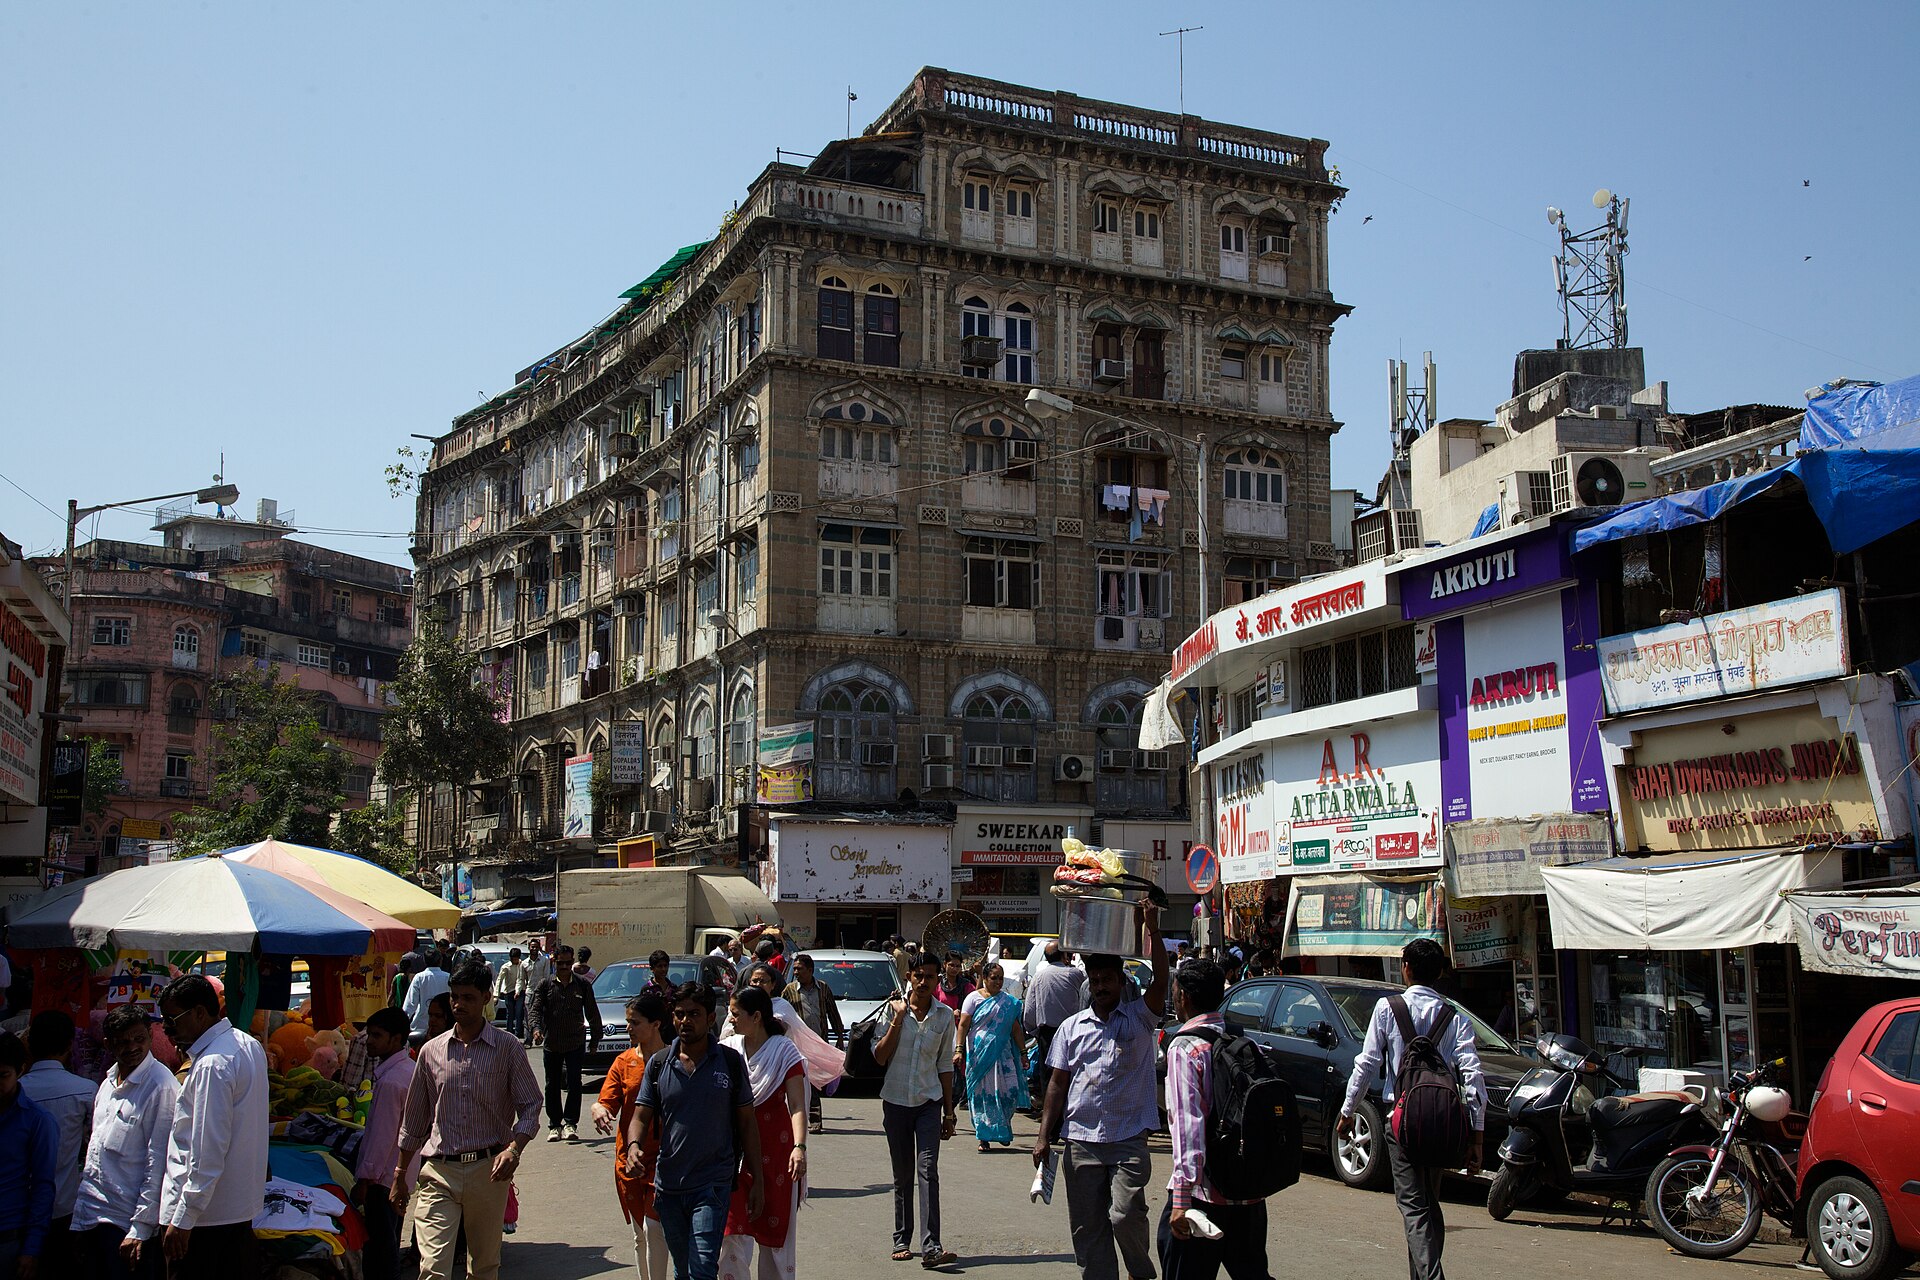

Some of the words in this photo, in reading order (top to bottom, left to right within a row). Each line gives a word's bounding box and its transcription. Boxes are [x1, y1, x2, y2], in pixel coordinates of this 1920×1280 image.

[1430, 549, 1516, 599] AKRUTI
[1256, 606, 1287, 634] आर.
[1290, 580, 1366, 622] अत्तरवाला
[1469, 662, 1559, 705] AKRUTI
[1531, 713, 1567, 730] JEWELLERY
[1631, 763, 1674, 801] SHAH
[1674, 747, 1786, 796] DWARKADAS
[1790, 736, 1860, 782] JIVRAJ
[1291, 780, 1418, 818] ATTARWALA
[977, 823, 1064, 840] SWEEKAR
[1548, 824, 1591, 840] AKRUTI
[1667, 817, 1693, 833] DRY
[989, 843, 1052, 852] COLLECTION
[973, 854, 1021, 862] IMMITATION
[1022, 855, 1065, 863] JEWELLERY
[1842, 910, 1910, 923] ORIGINAL
[570, 922, 620, 936] SANGEETA
